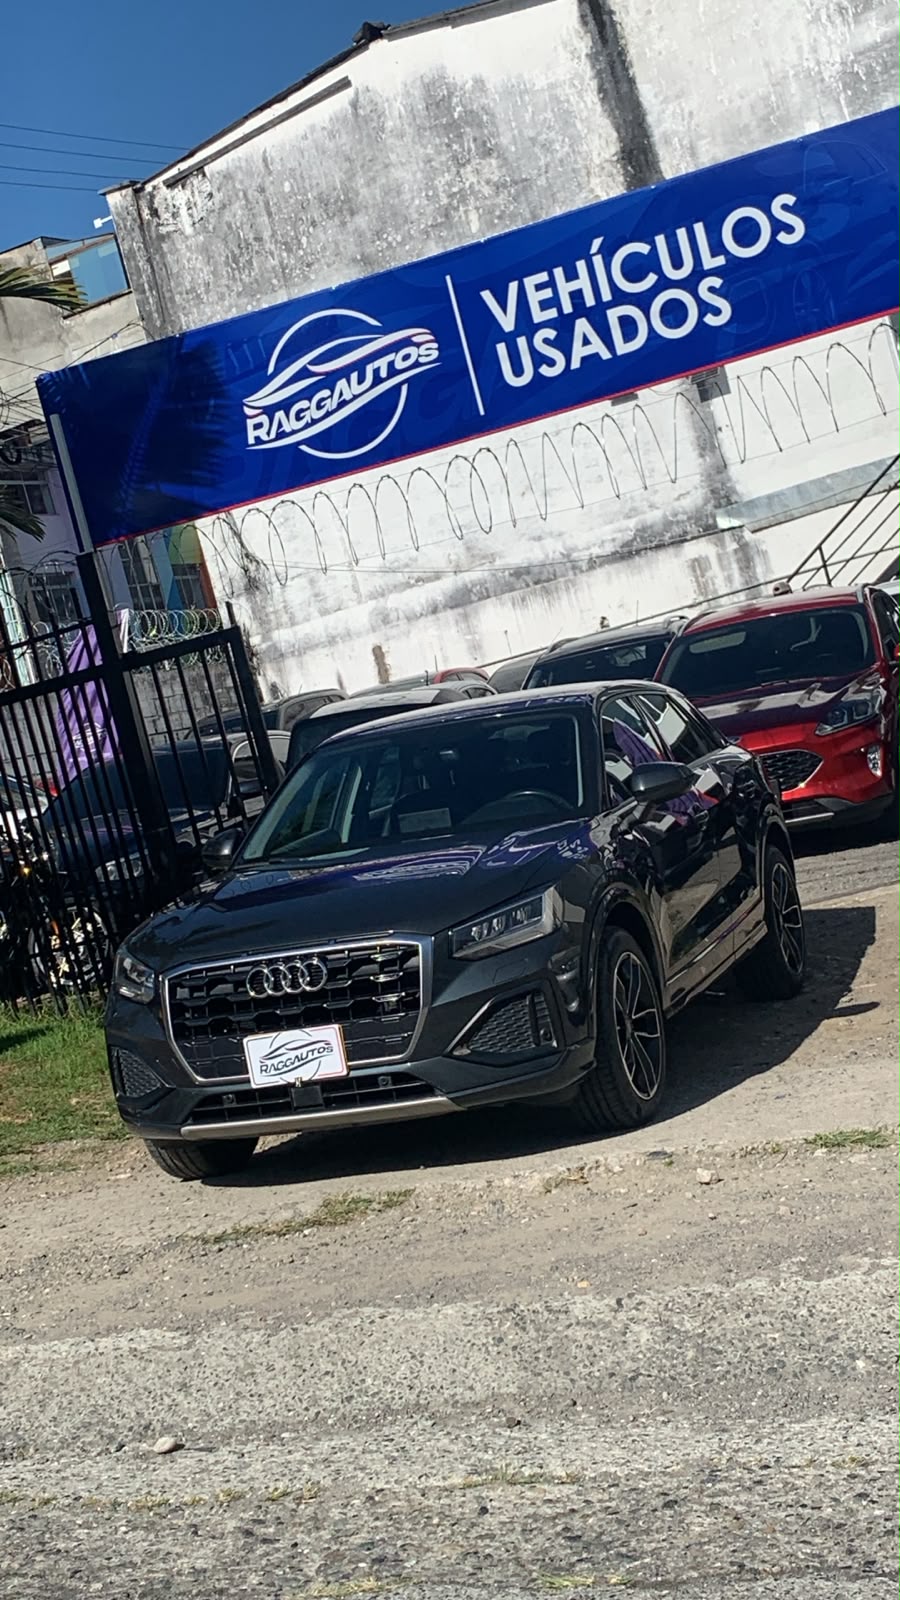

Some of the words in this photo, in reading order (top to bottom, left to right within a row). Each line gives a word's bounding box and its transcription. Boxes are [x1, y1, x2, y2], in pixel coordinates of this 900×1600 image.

[479, 193, 806, 334] VEHÍCULOS
[495, 276, 733, 388] USADOS
[246, 341, 440, 446] RAGGAUTOS
[259, 1045, 334, 1075] RAGGAUTOS
